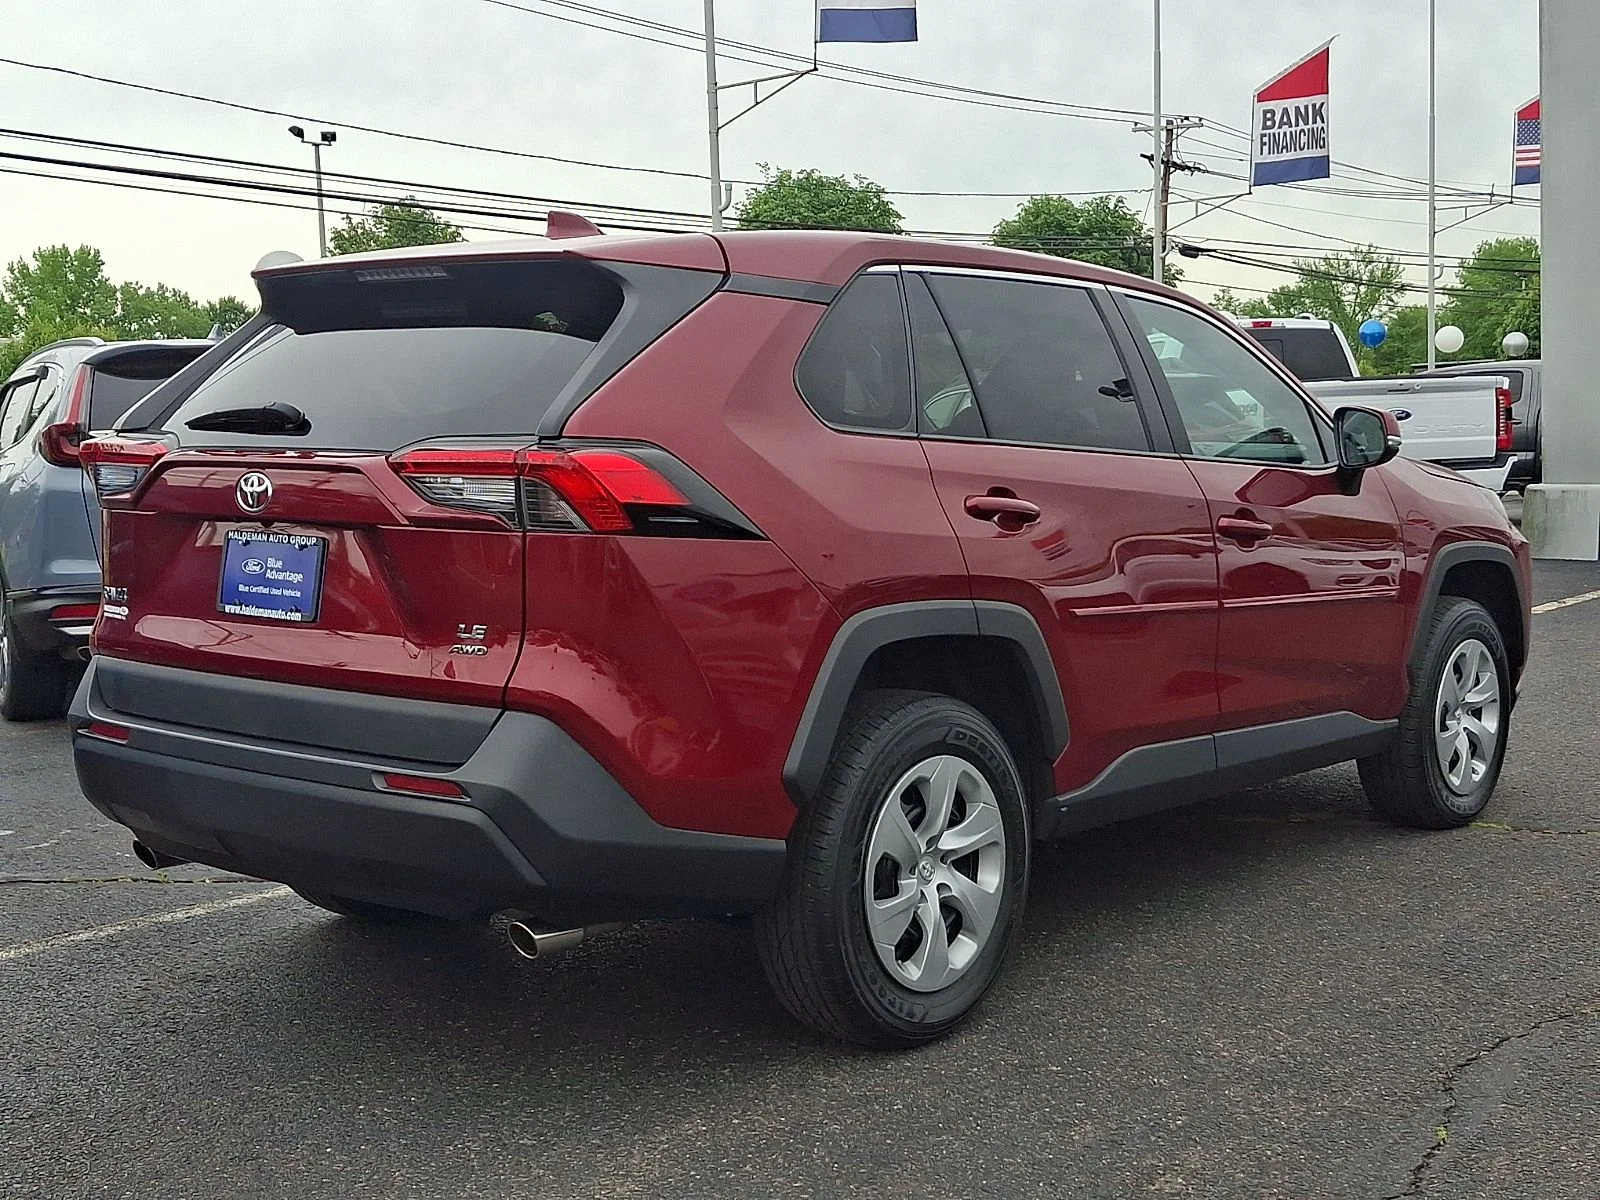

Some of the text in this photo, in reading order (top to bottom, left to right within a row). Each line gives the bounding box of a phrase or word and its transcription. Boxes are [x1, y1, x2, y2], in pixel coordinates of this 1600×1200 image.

[1261, 101, 1326, 131] BANK
[1259, 126, 1326, 156] FINANCING
[228, 530, 317, 546] HALDEMAN AUTO GROUP
[267, 557, 283, 569] Blue
[265, 569, 304, 584] Advantage
[238, 584, 301, 598] Blue Certified Used Vehicle
[224, 603, 302, 621] www.haldemanauto.com
[456, 623, 488, 640] LE
[447, 644, 488, 656] AWD
